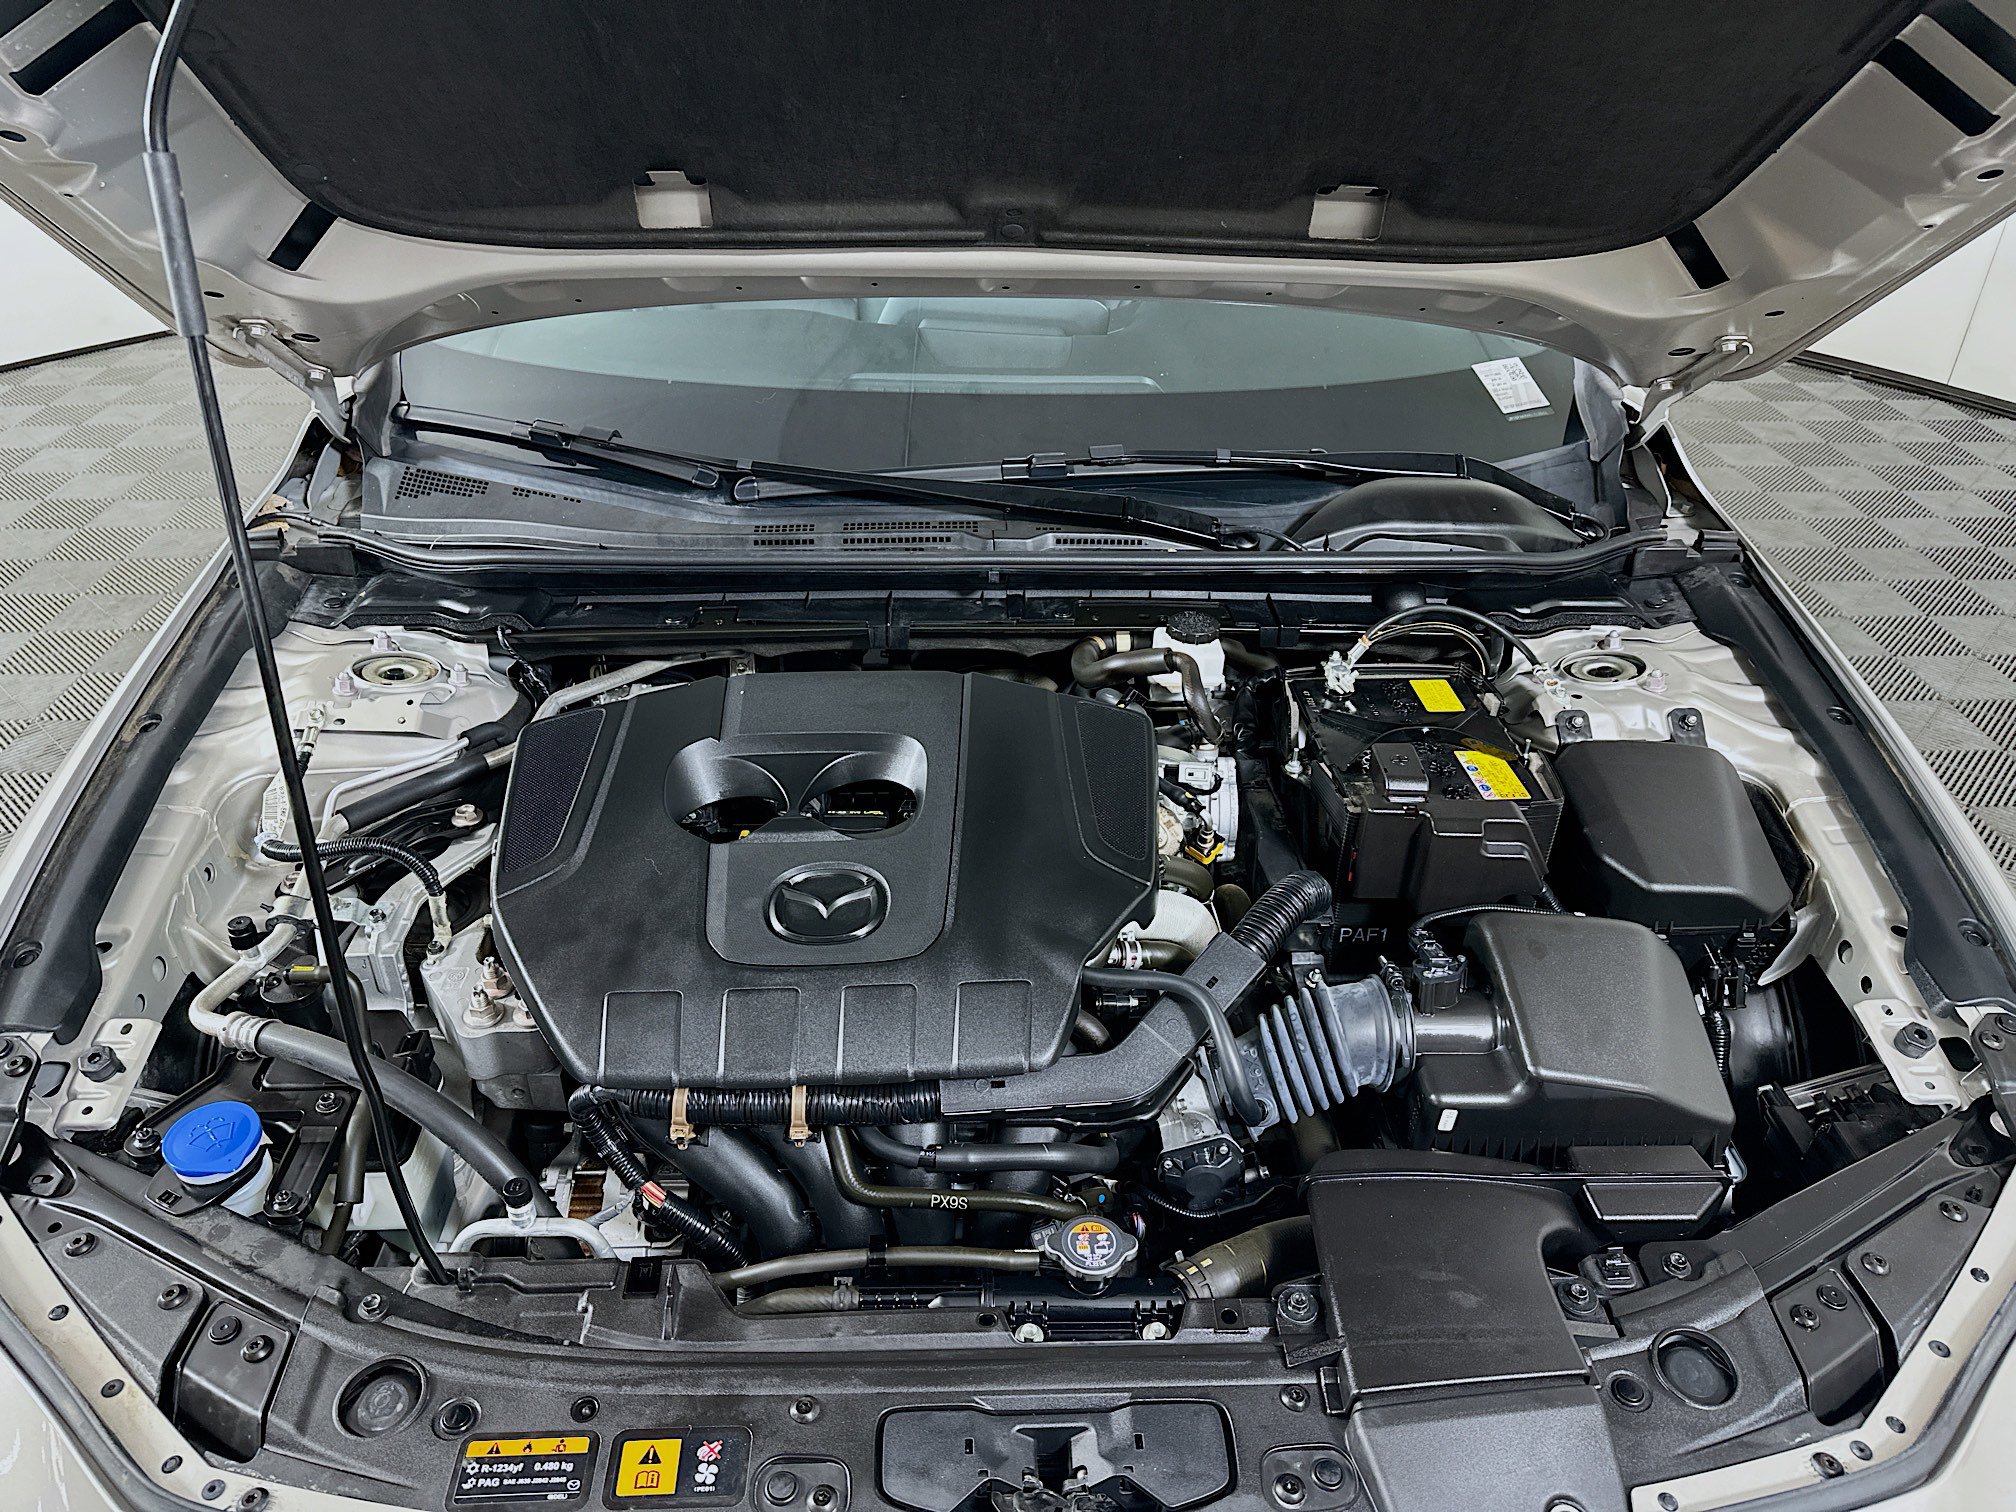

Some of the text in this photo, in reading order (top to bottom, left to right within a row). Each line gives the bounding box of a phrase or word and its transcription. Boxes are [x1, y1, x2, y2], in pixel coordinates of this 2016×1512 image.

[1339, 927, 1388, 943] PAF1
[930, 1194, 968, 1210] PX9S
[480, 1461, 574, 1474] R-1234yf 0.480 kg
[477, 1477, 500, 1488] PAG
